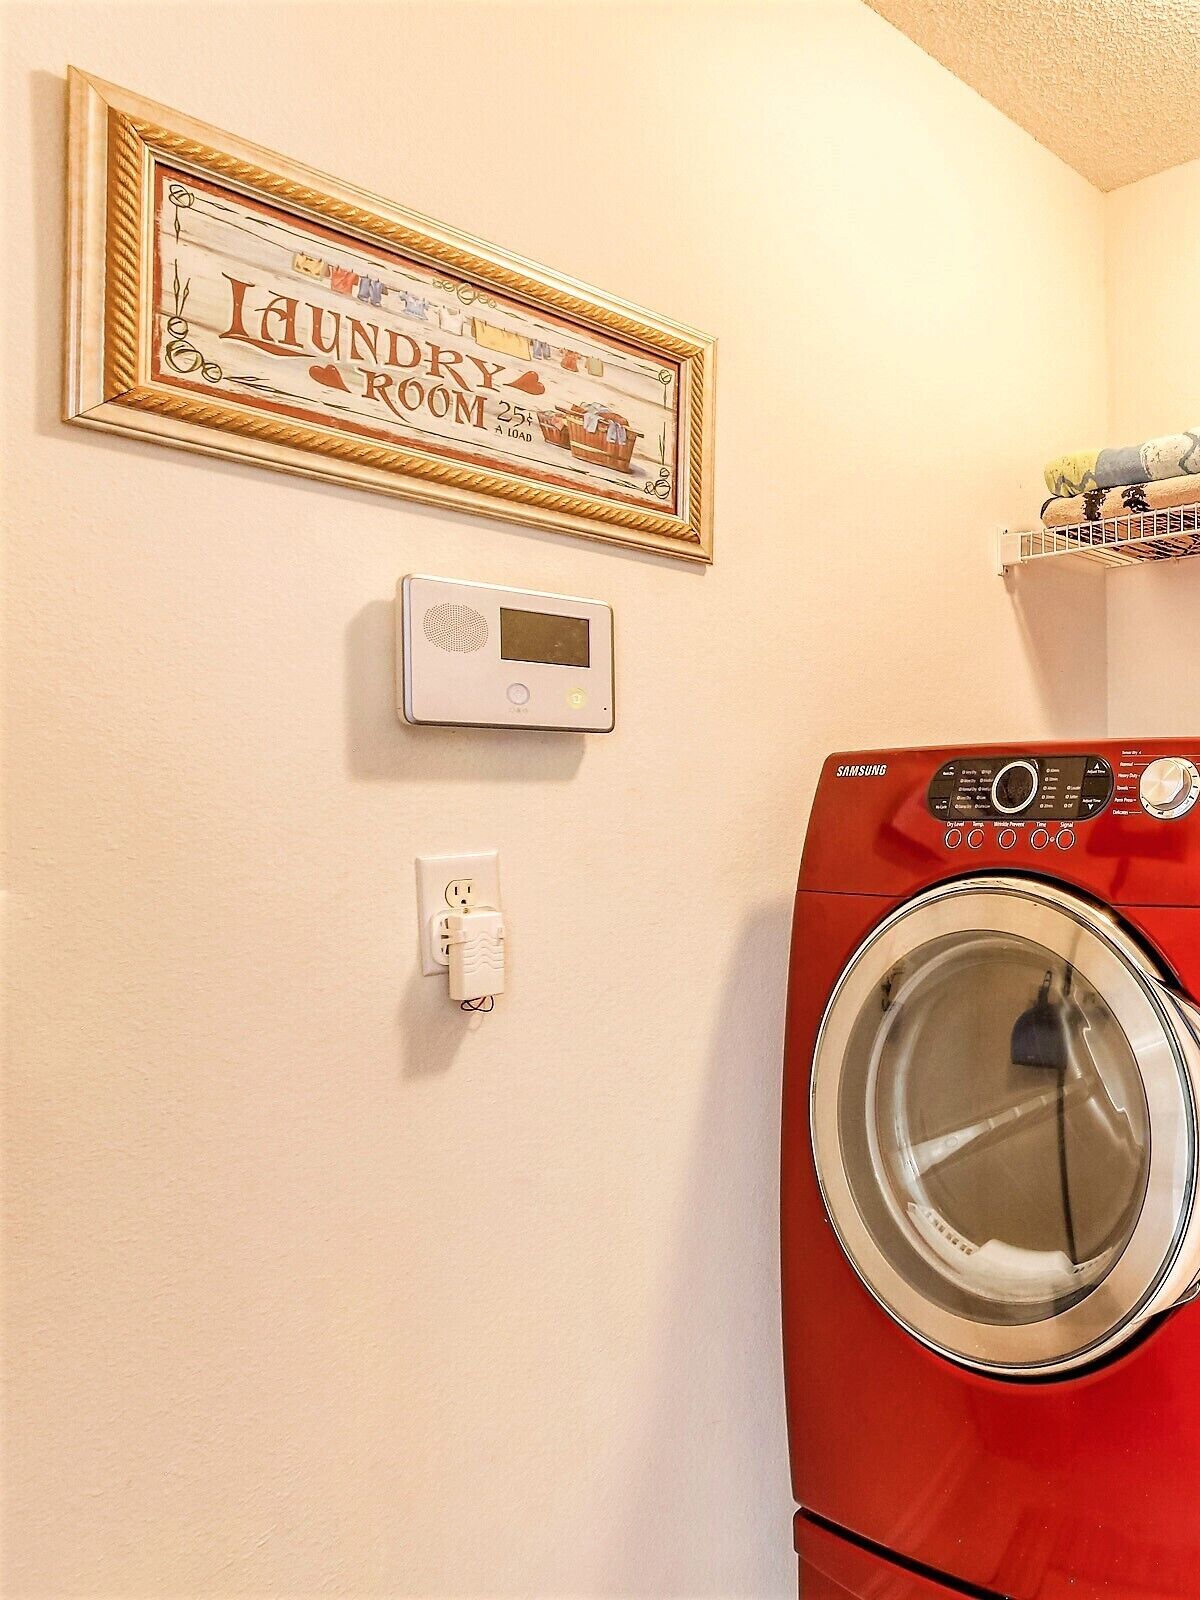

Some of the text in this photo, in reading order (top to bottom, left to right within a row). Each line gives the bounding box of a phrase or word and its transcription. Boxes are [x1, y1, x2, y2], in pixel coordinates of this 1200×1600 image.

[219, 272, 506, 392] LAUNDRY
[358, 367, 488, 430] ROOM
[497, 400, 533, 427] 25¢
[494, 425, 532, 442] A LOAD
[837, 765, 887, 777] SAMSUNG
[1060, 821, 1074, 829] Signal
